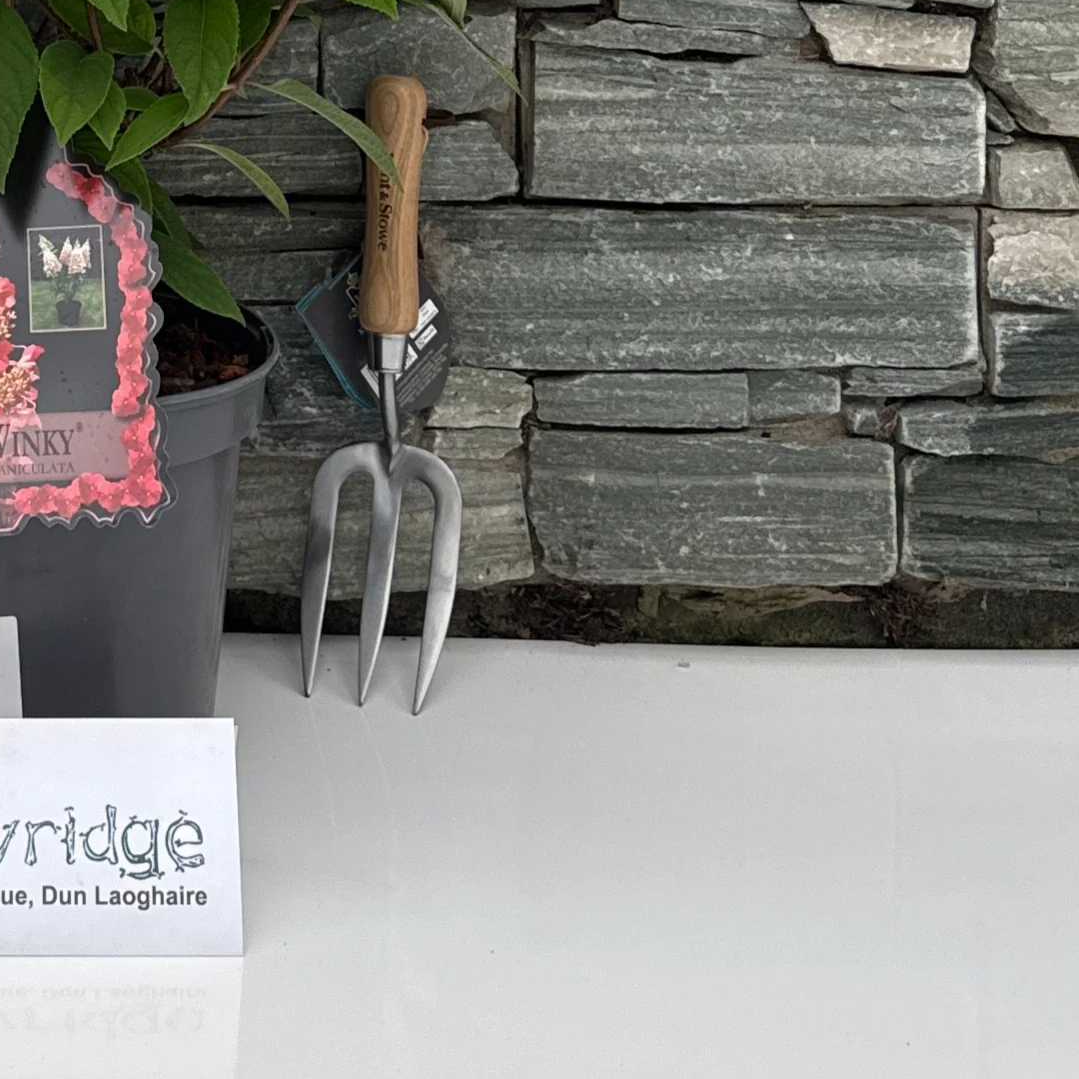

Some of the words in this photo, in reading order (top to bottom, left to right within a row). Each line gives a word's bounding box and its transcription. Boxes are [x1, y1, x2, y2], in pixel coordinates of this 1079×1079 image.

[379, 191, 389, 201] &
[377, 203, 393, 252] Stowe
[41, 885, 87, 907] Dun
[94, 884, 208, 911] Laoghaire
